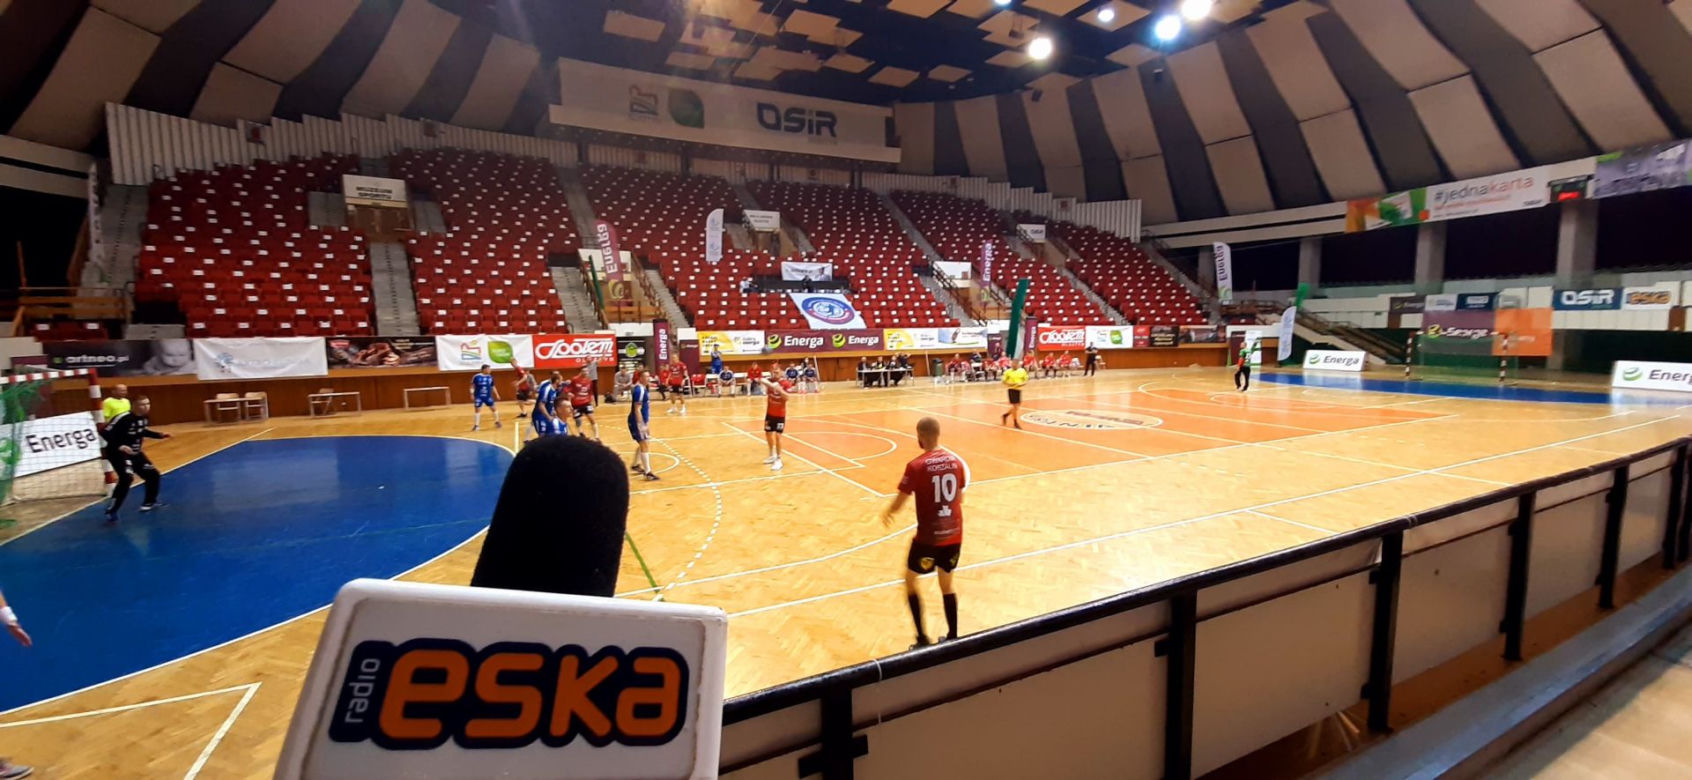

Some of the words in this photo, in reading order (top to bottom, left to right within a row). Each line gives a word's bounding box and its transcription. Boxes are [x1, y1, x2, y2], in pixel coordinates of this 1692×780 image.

[597, 224, 618, 273] Energa
[659, 328, 668, 360] Energa
[784, 335, 824, 349] Energa
[848, 335, 879, 346] Energa
[1323, 355, 1360, 367] Energa
[25, 428, 97, 454] Energa
[931, 473, 957, 503] 10
[345, 657, 380, 724] radio
[378, 648, 681, 738] eska
